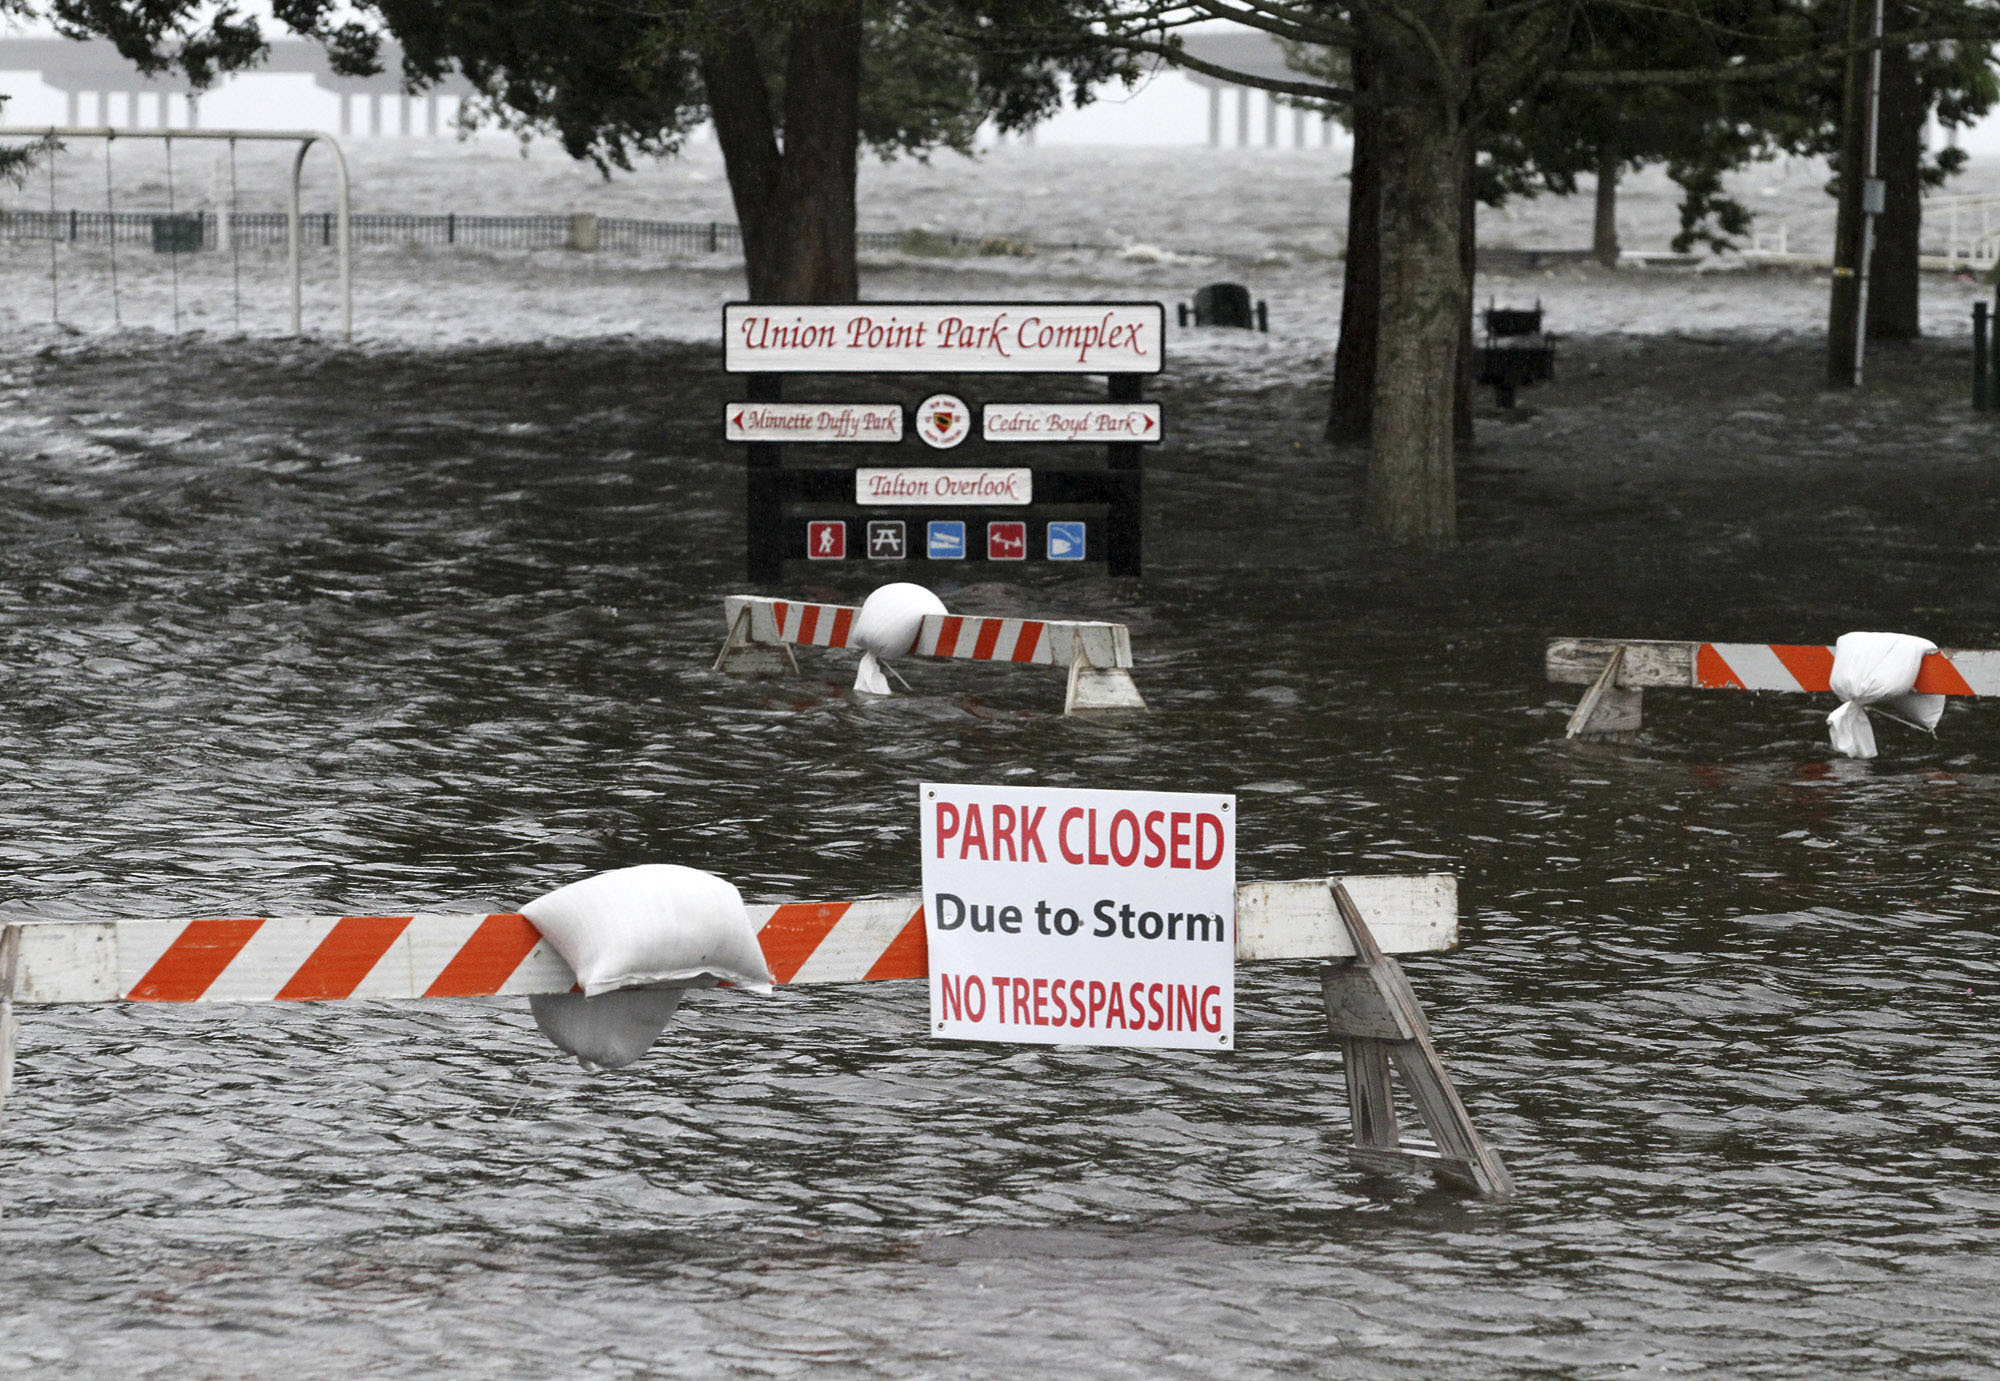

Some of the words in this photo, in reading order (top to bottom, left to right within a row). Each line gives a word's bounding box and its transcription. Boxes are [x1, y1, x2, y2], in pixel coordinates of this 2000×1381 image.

[742, 316, 837, 349] Union
[846, 316, 928, 349] Point
[937, 312, 1011, 358] Park
[1017, 311, 1148, 363] Complex
[748, 408, 814, 431] Minnette
[817, 408, 861, 438] Duffy
[863, 408, 898, 436] Park
[987, 410, 1040, 432] Cedric
[1046, 411, 1092, 440] Boyd
[1095, 410, 1140, 435] Park
[869, 472, 929, 496] Talton
[934, 472, 1020, 500] Overlook
[936, 801, 1048, 863] PARK
[1058, 806, 1226, 871] CLOSED
[936, 893, 1023, 934] Due
[1034, 900, 1080, 936] to
[1093, 899, 1225, 942] Storm
[941, 973, 986, 1023] NO
[992, 976, 1222, 1034] TRESSPASSING
